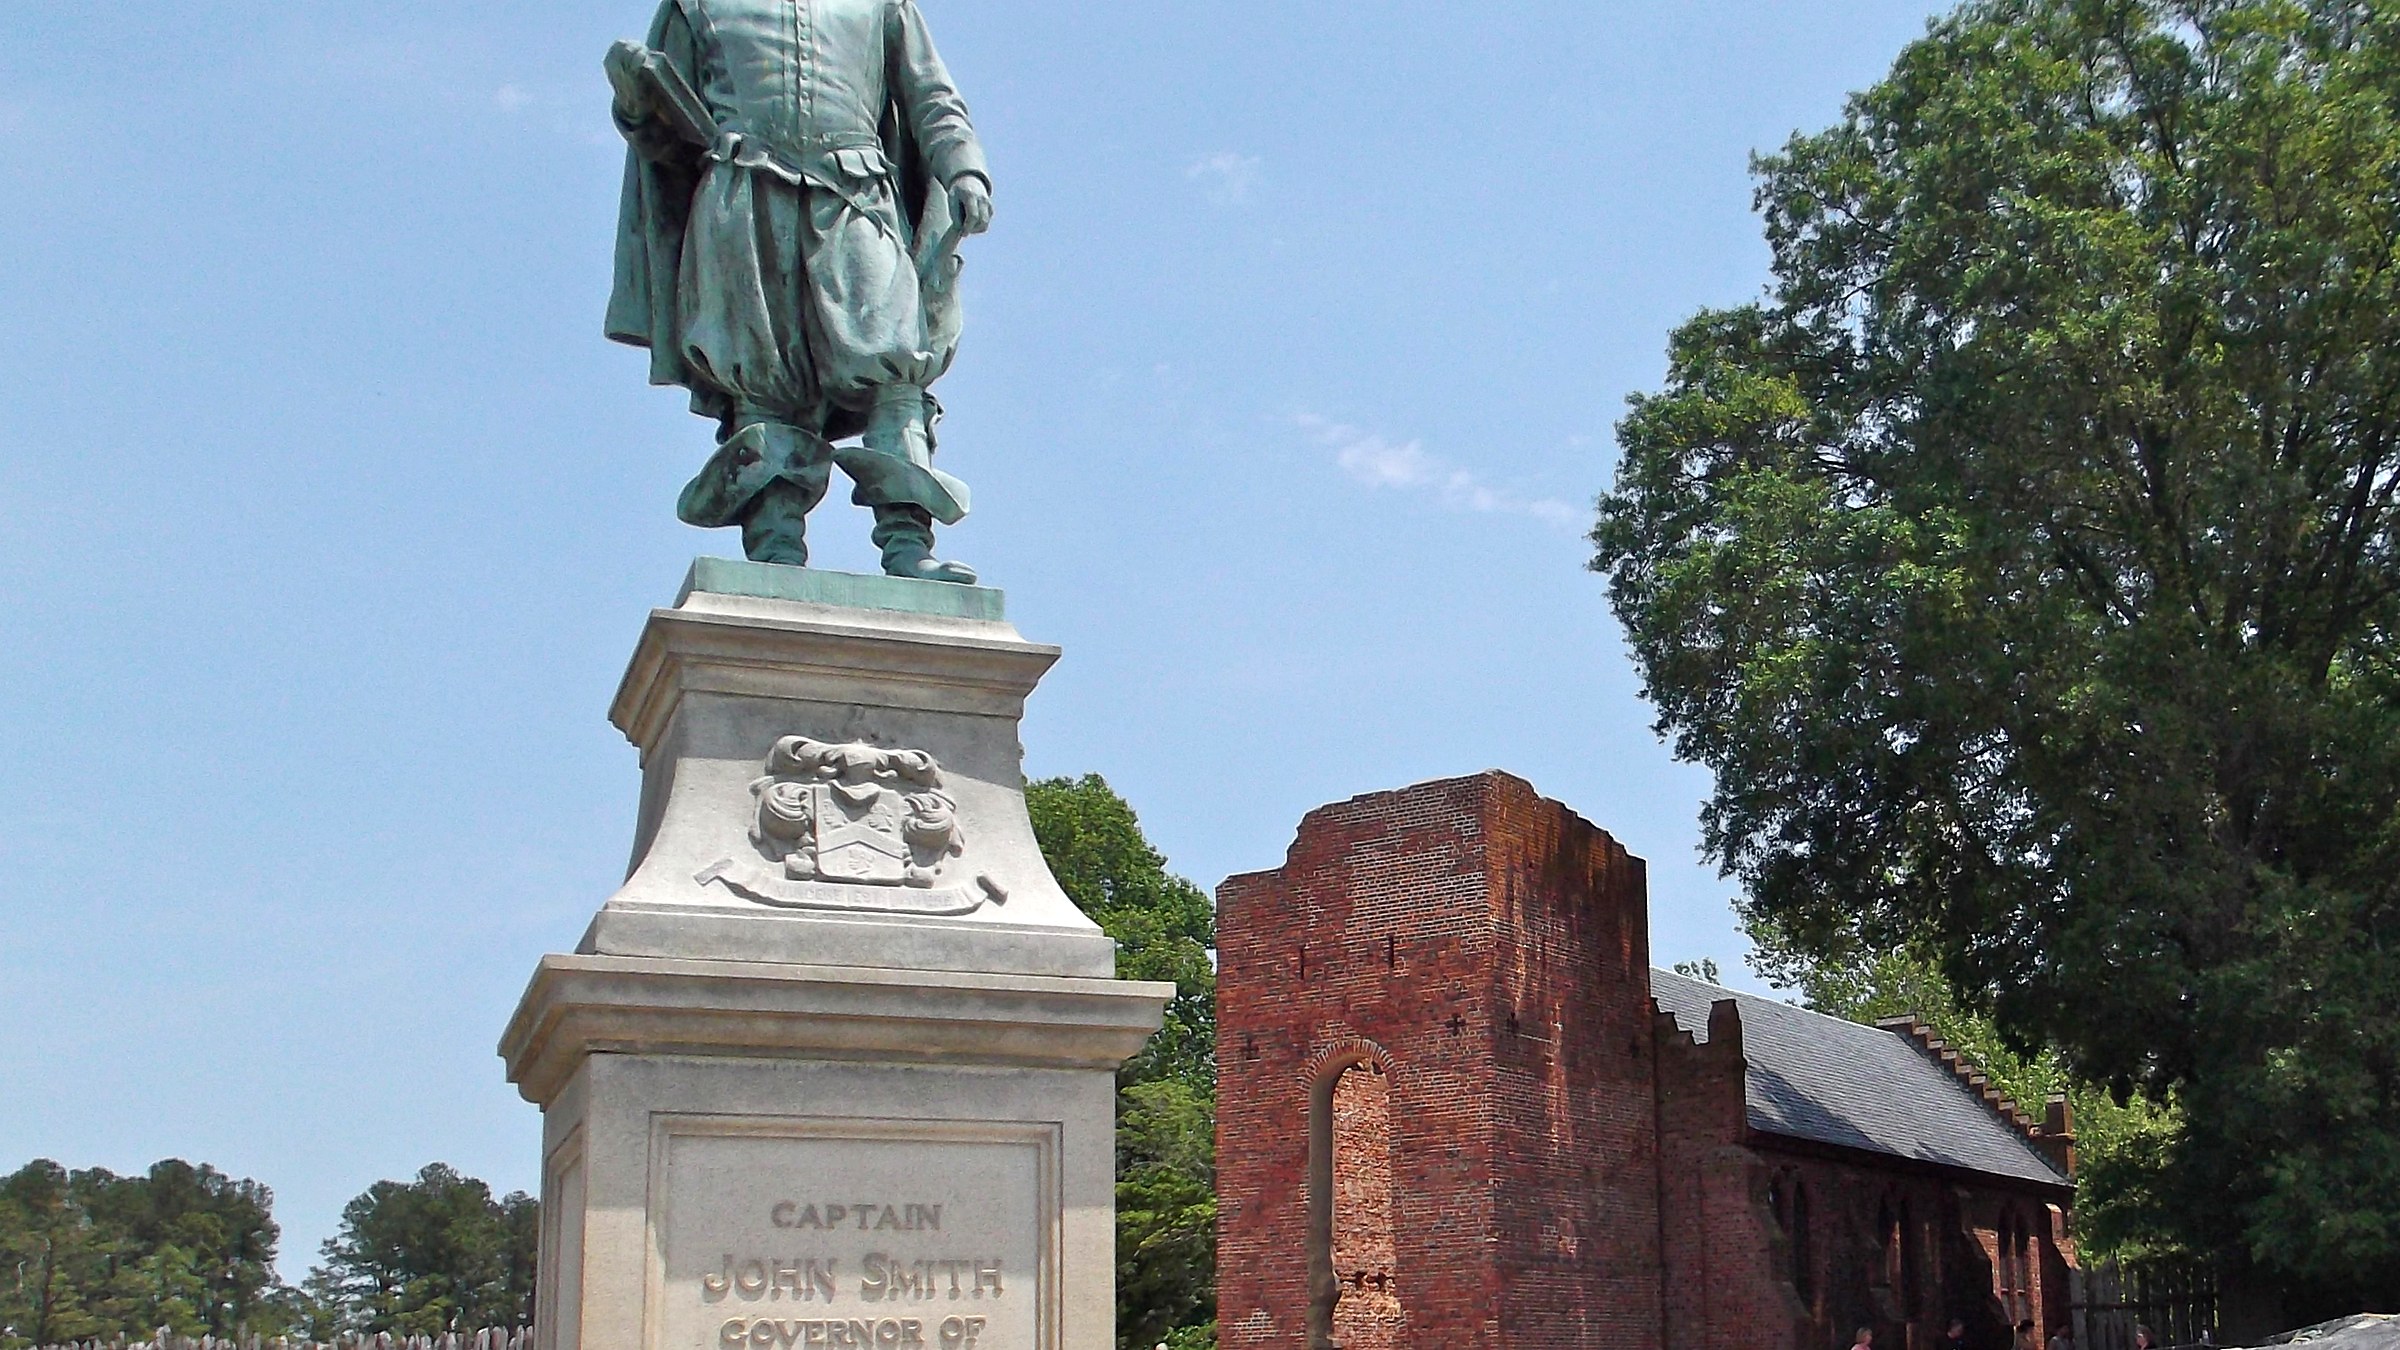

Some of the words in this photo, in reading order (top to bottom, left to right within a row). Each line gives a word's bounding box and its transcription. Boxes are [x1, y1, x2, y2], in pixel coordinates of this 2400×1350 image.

[770, 1201, 943, 1231] CAPTAIN
[703, 1253, 839, 1302] JOHN
[861, 1251, 1005, 1300] SMITH
[719, 1316, 926, 1346] GOVERNOR
[939, 1314, 987, 1346] OF
